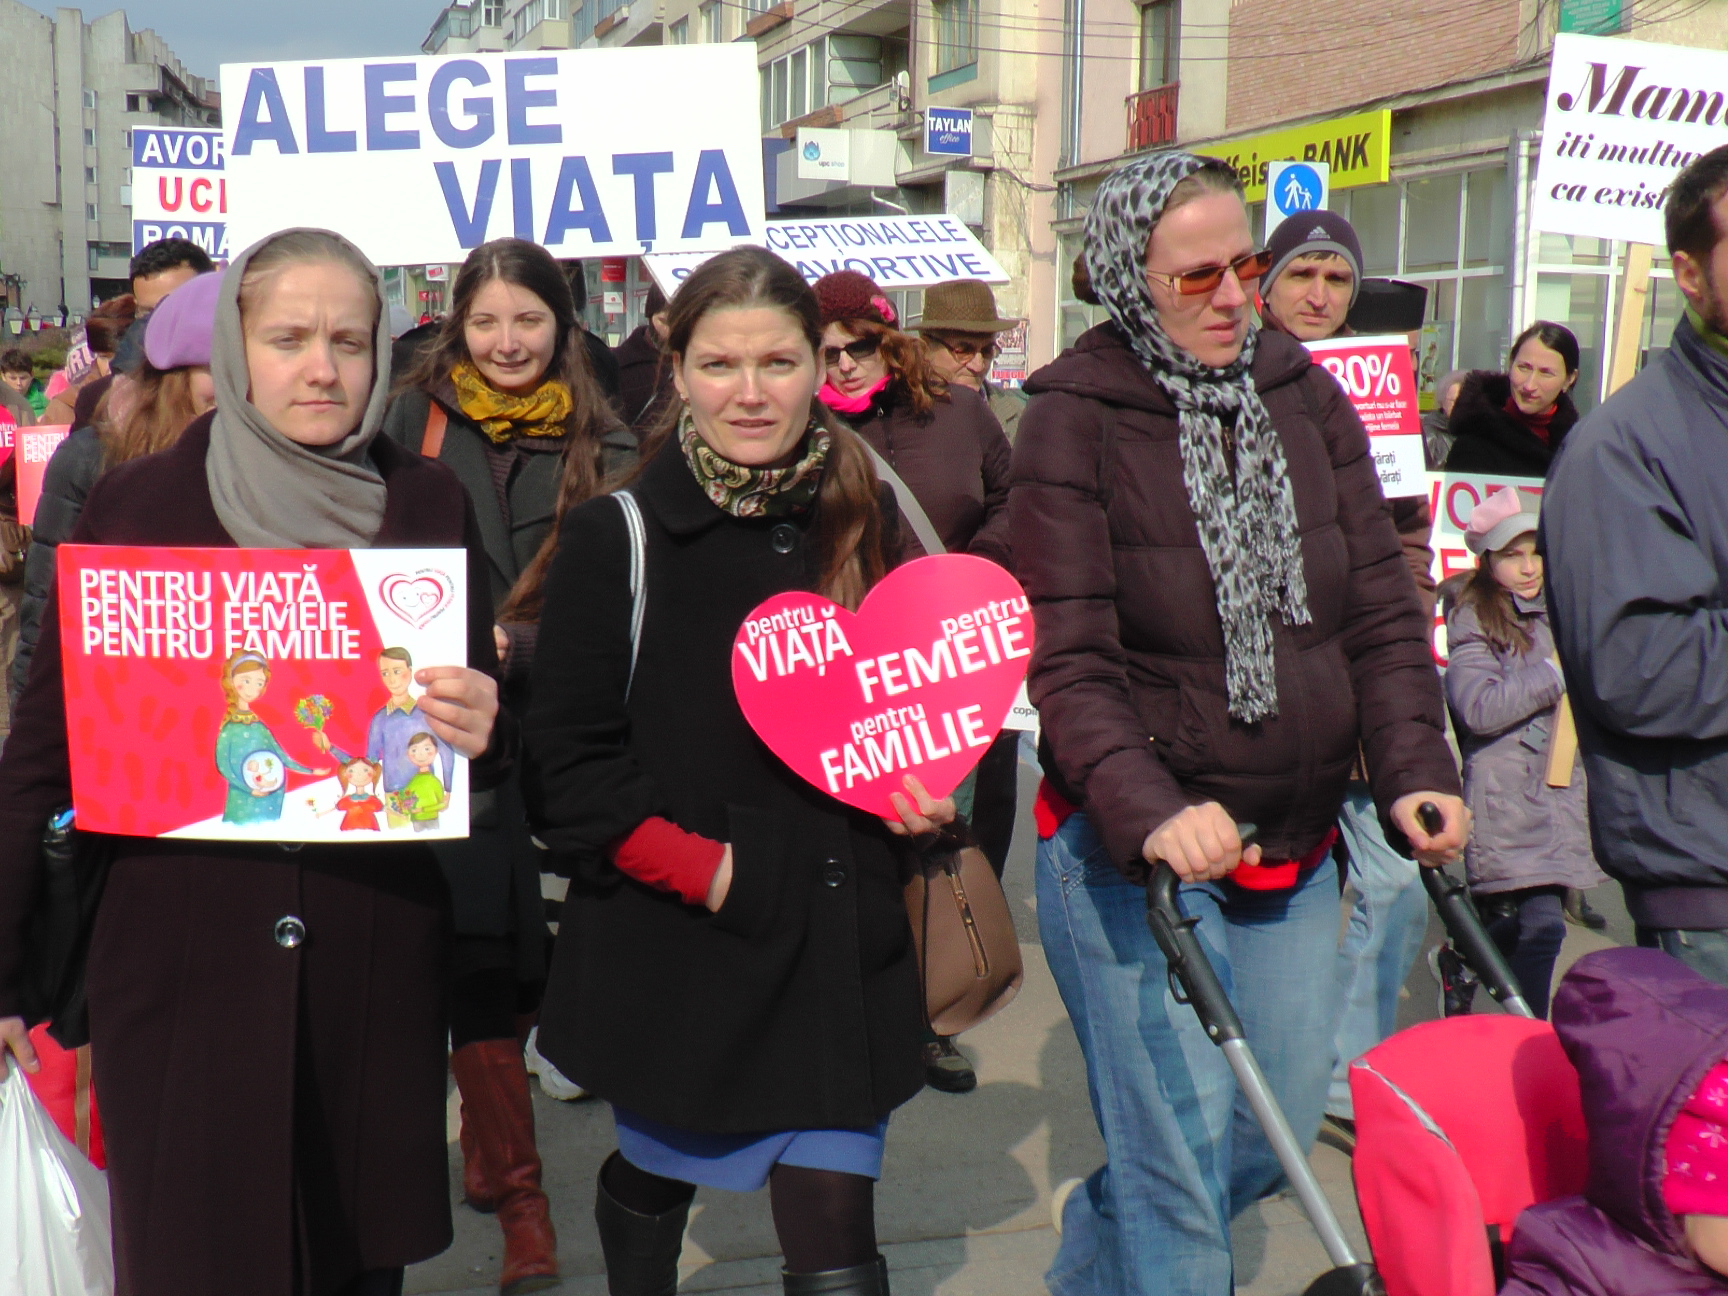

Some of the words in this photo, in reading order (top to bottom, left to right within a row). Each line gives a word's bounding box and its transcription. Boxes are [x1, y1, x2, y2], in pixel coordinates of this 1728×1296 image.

[232, 57, 563, 155] ALEGE
[1557, 61, 1728, 126] Mam
[929, 116, 971, 133] TAYLAN
[158, 176, 227, 213] UCI
[433, 149, 752, 255] VIAȚA
[1550, 182, 1588, 203] ca
[1321, 352, 1400, 398] 80%
[80, 568, 211, 602] PENTRU
[82, 599, 212, 630] PENTRU
[224, 601, 348, 631] FEMEIE
[744, 605, 815, 646] pentru
[941, 595, 1031, 641] pentru
[83, 628, 213, 659] PENTRU
[225, 630, 361, 659] FAMILIE
[738, 606, 853, 682] VIAȚĂ
[855, 617, 1031, 703] FEMEIE
[850, 703, 926, 745] pentru
[820, 704, 991, 794] FAMILIE
